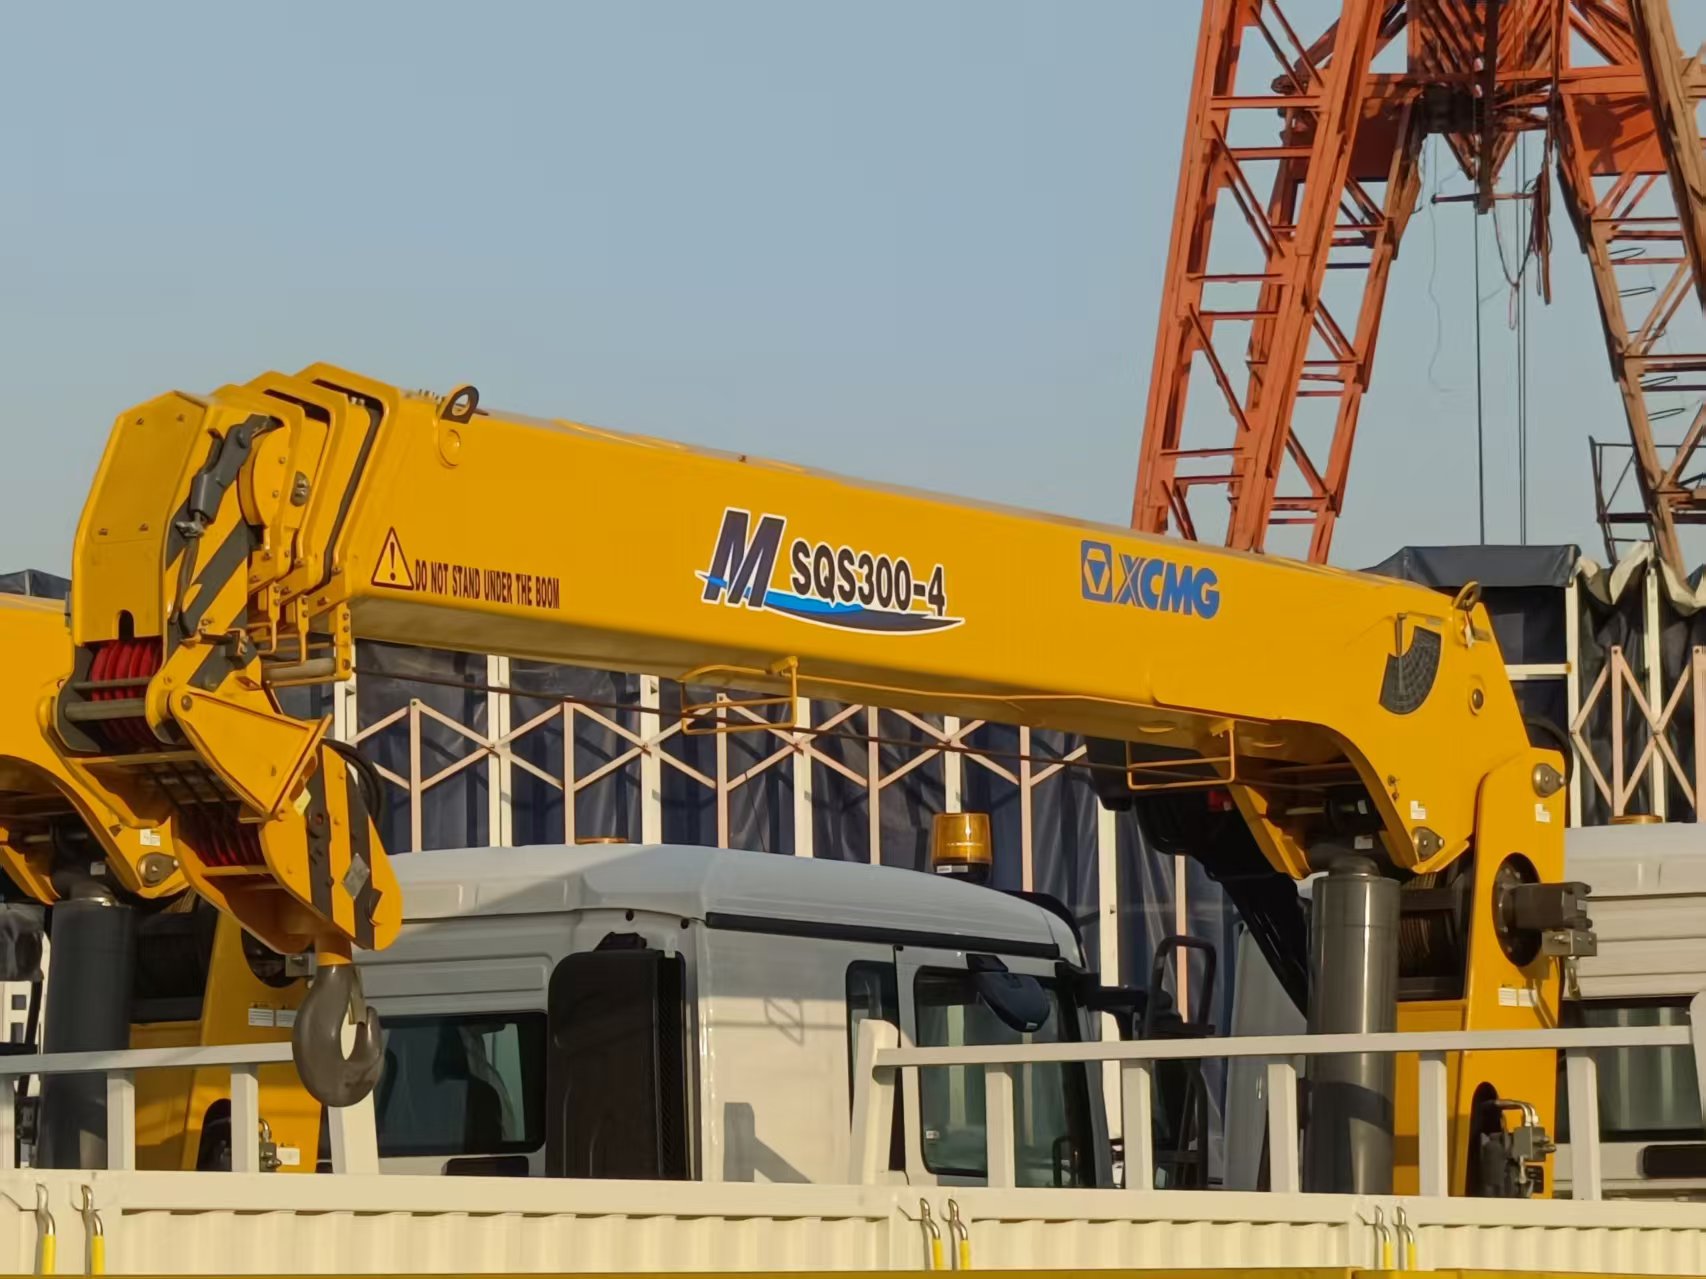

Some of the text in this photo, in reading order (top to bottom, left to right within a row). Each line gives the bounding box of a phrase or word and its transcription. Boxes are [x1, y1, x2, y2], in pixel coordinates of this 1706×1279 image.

[415, 559, 560, 609] DO NOT STAND UNDER THE BOOM
[702, 508, 946, 617] M SQS300-4
[1114, 553, 1220, 619] XCMG
